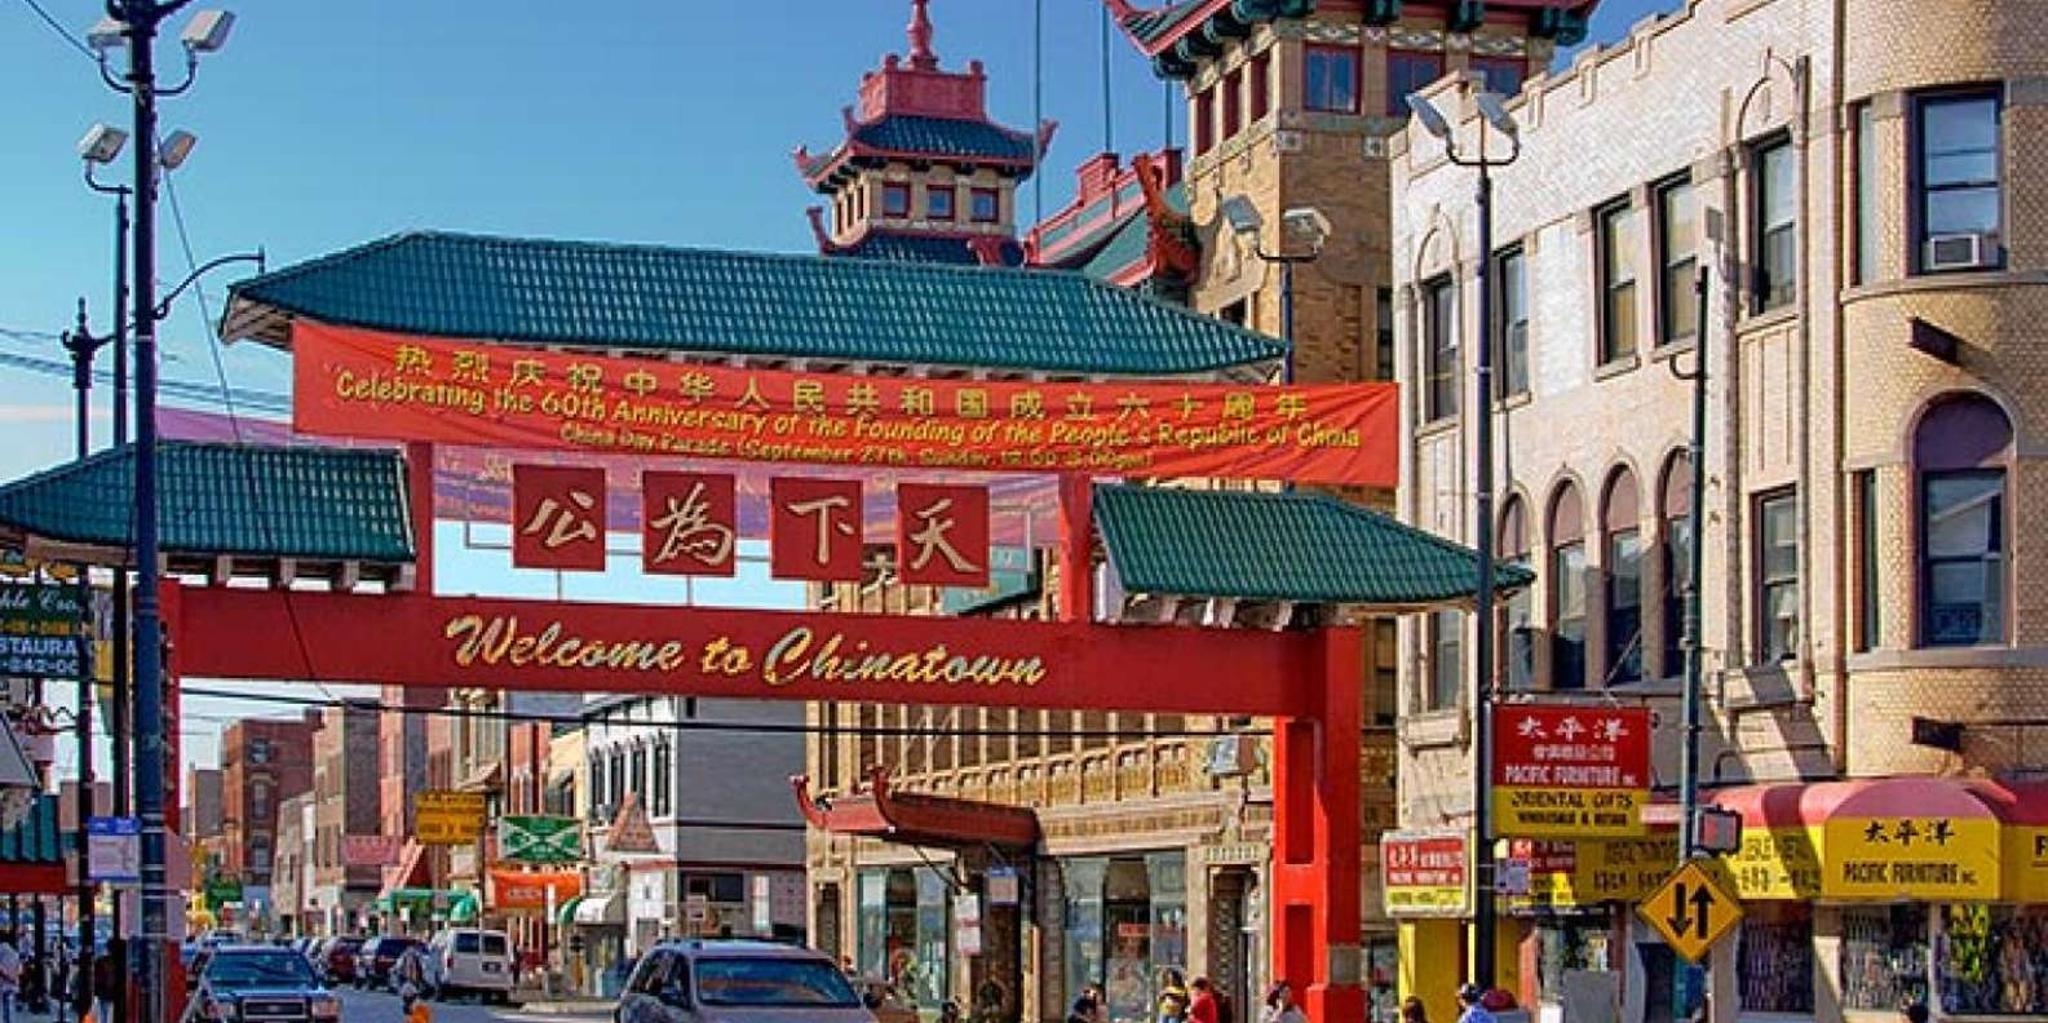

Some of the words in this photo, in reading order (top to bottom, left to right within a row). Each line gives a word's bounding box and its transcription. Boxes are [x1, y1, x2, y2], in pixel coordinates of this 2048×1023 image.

[335, 369, 485, 414] Celebrating
[493, 383, 534, 413] the
[541, 390, 606, 421] 60th
[612, 399, 768, 434] Anniversary
[774, 413, 798, 435] of
[808, 414, 847, 437] the
[853, 416, 965, 447] Founding
[971, 419, 1001, 443] of
[1006, 421, 1042, 444] the
[1158, 423, 1261, 451] Republic
[1266, 425, 1291, 444] of
[1297, 421, 1360, 447] China
[561, 421, 615, 446] China
[619, 428, 655, 451] Day
[660, 432, 730, 455] Parade
[445, 615, 685, 671] Welcome
[702, 637, 753, 674] to
[764, 627, 1046, 685] Chinatown
[1516, 715, 1630, 742] 太平洋
[1505, 765, 1550, 783] PACIFIC
[1553, 766, 1620, 785] FURNITURE
[1511, 791, 1585, 808] ORIENTAL
[1864, 820, 1955, 846] 太平洋
[1843, 863, 1888, 884] PACIFIC
[1892, 863, 1958, 884] FURNITURE
